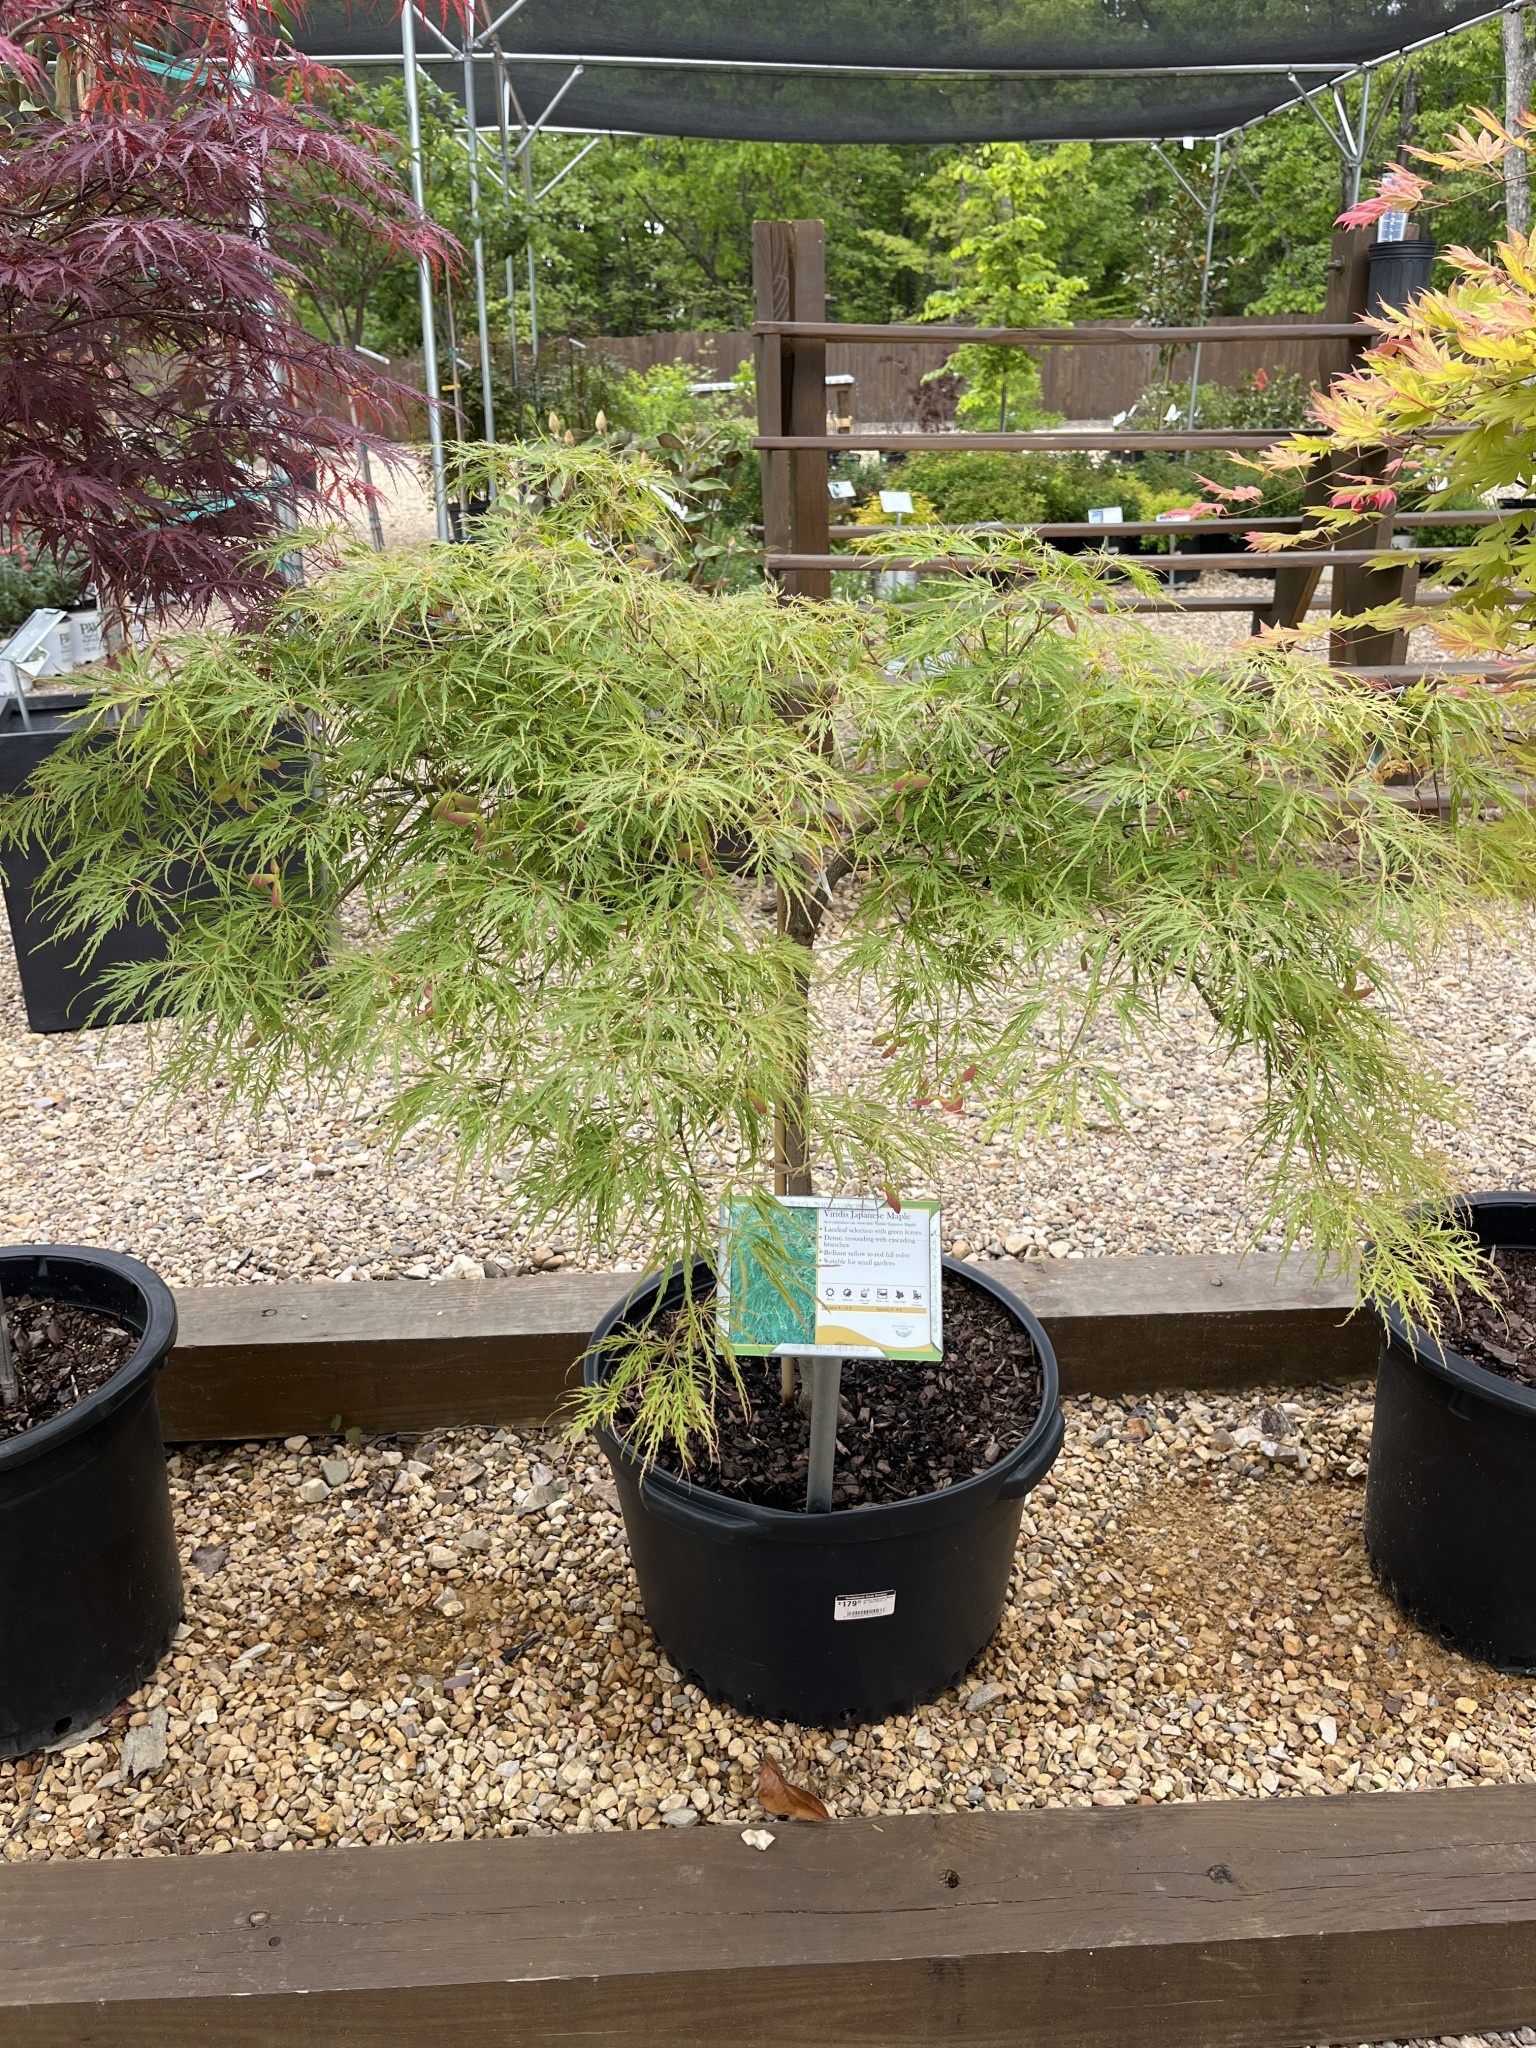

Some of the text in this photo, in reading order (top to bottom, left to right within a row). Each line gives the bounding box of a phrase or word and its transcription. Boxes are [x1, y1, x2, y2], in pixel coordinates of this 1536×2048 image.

[824, 1209, 911, 1222] Viridis Japanese Maple
[904, 1228, 922, 1236] leaves
[888, 1237, 916, 1245] cascading
